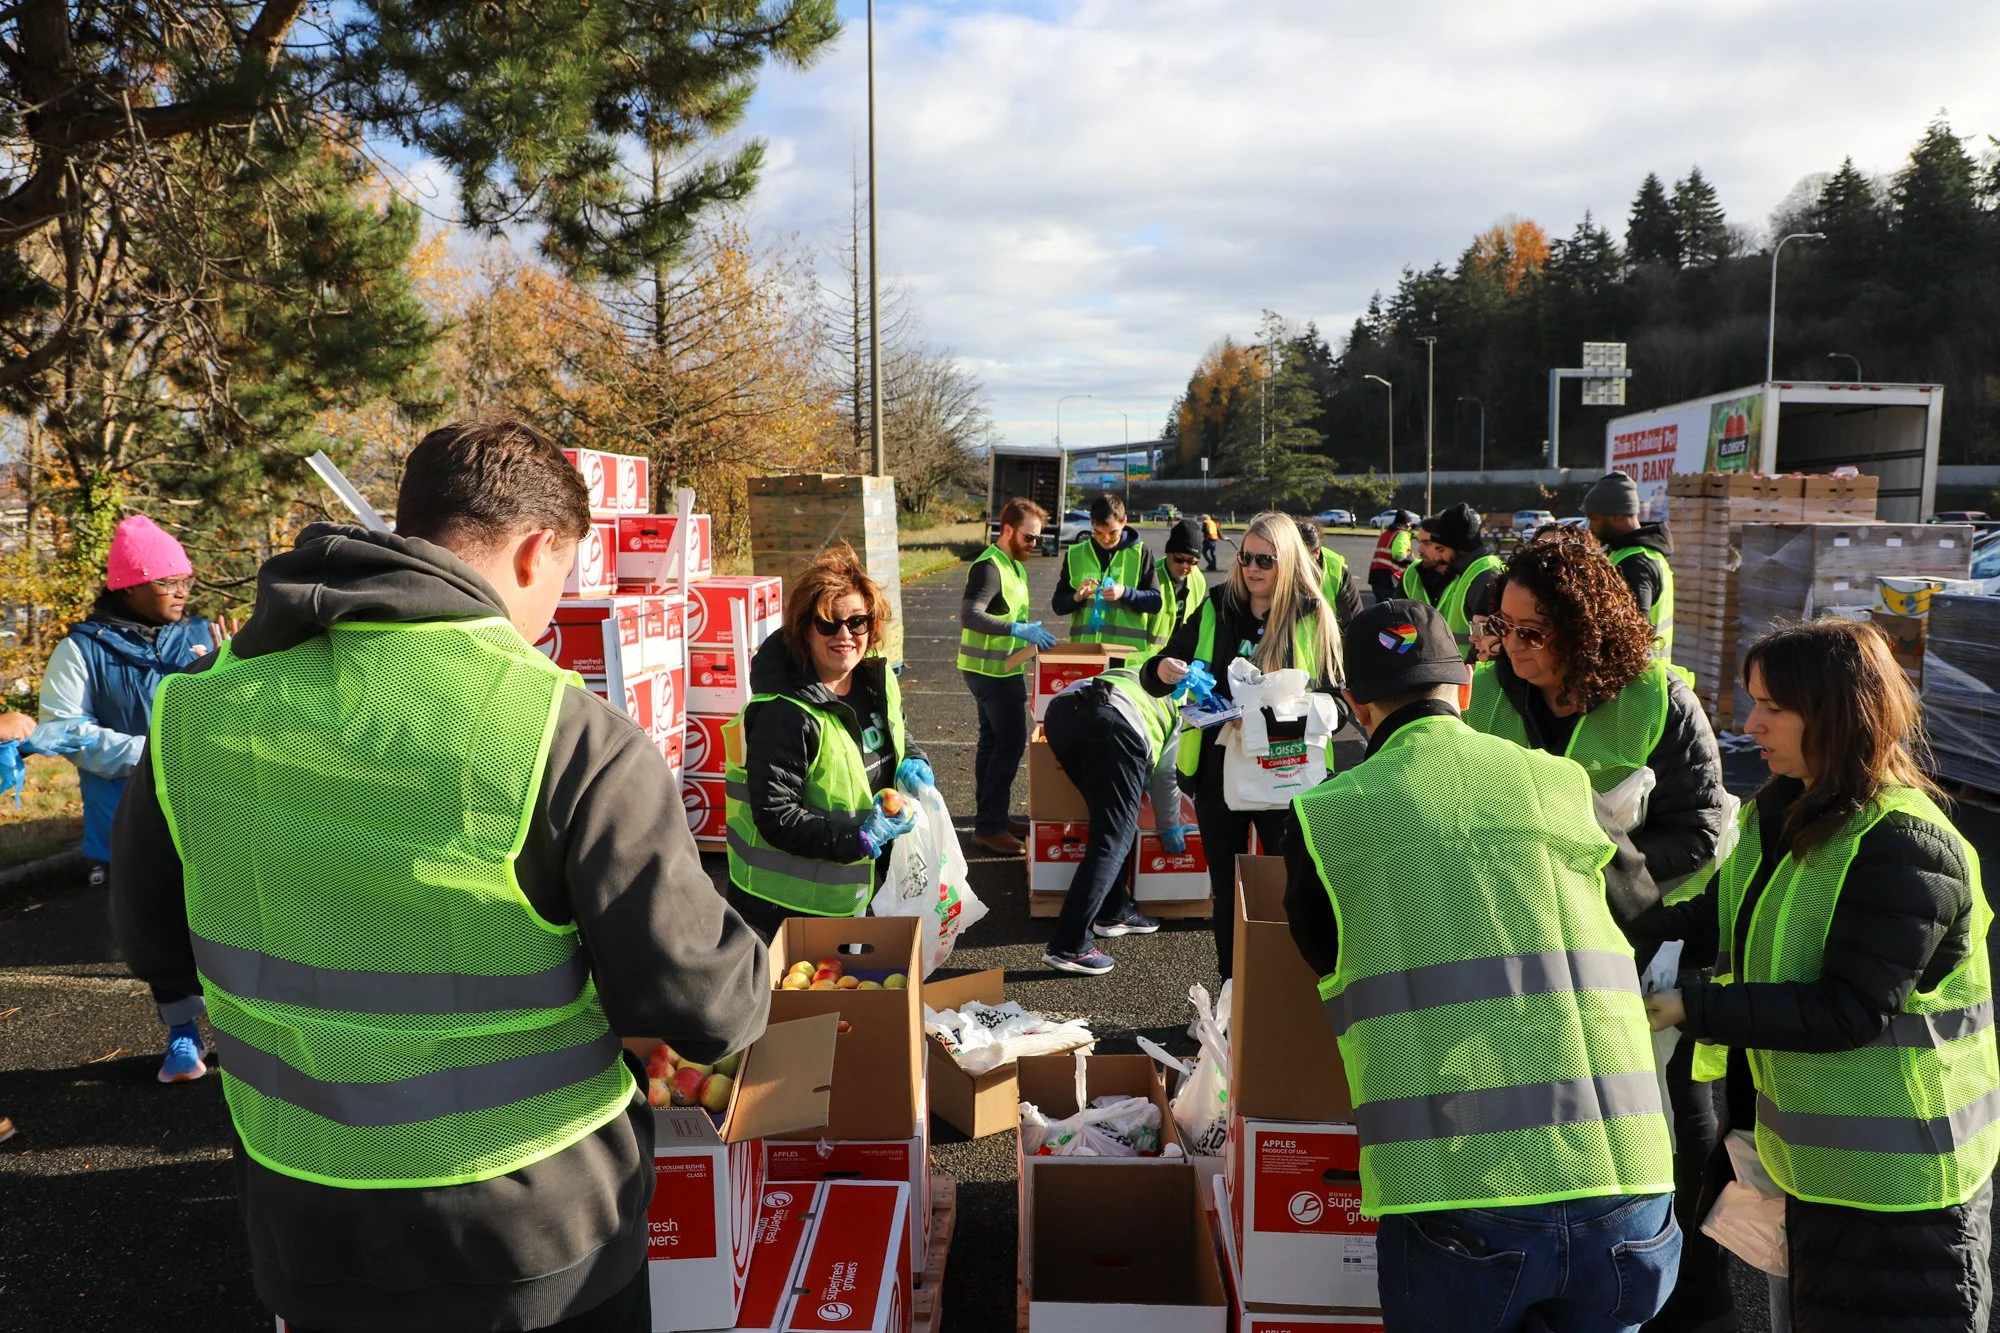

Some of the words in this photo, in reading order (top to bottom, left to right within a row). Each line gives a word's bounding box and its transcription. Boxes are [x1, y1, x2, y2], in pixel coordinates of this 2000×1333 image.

[1642, 458, 1675, 482] BANK
[1270, 743, 1303, 757] LOISE'S
[1269, 758, 1291, 767] Cooking
[1263, 1140, 1297, 1148] APPLES
[1328, 1198, 1361, 1211] supe
[648, 1218, 679, 1232] resh
[755, 1217, 770, 1243] growers
[764, 1209, 785, 1244] superfresh
[648, 1233, 680, 1246] wers
[826, 1262, 846, 1301] superfresh
[842, 1261, 859, 1291] growers
